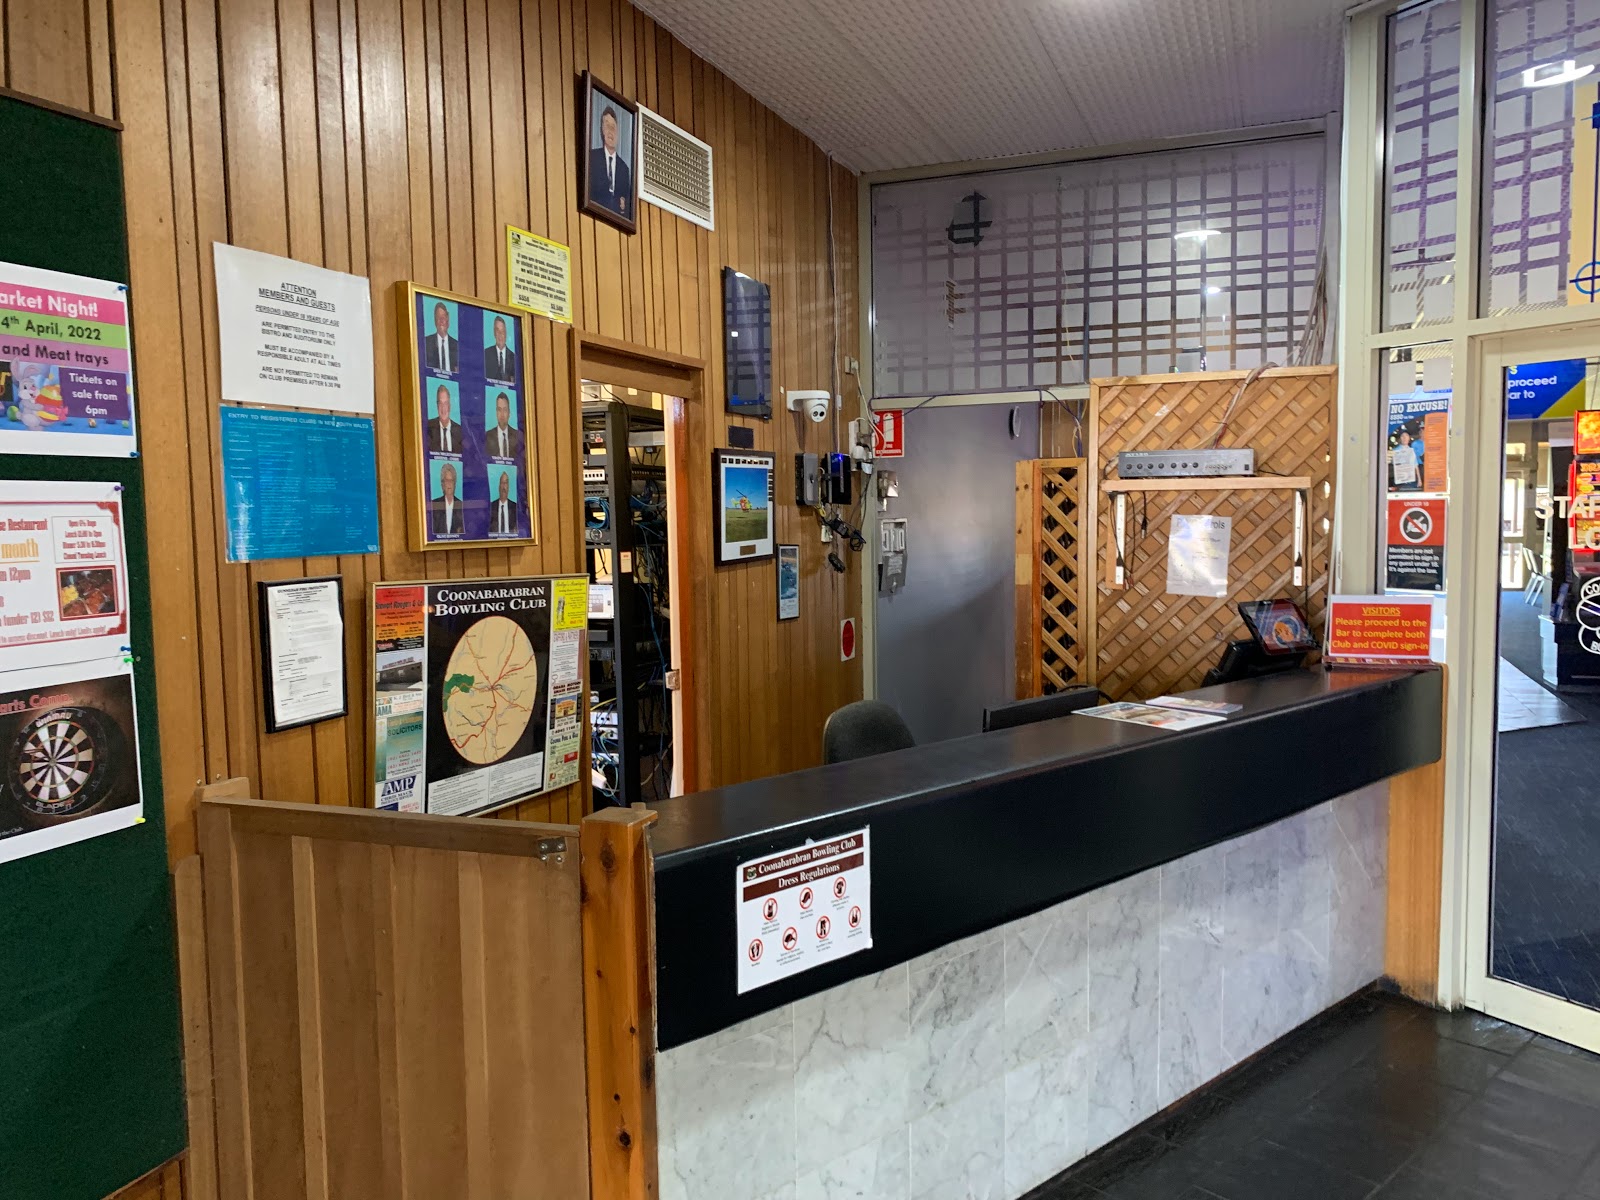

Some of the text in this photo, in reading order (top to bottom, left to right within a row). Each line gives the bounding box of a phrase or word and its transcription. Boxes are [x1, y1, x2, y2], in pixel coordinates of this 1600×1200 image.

[281, 282, 317, 298] ATTENTION
[47, 295, 99, 318] Night!
[258, 287, 336, 312] MEMBERS AND GUESTS
[255, 304, 281, 317] PERSONS
[282, 310, 299, 319] UNDER
[306, 315, 322, 323] YEARS
[330, 319, 340, 327] AGE
[25, 320, 63, 338] April,
[67, 325, 102, 341] 2022
[273, 322, 302, 333] PERMITTED
[261, 328, 281, 337] BISTRO
[293, 334, 323, 344] AUDITORIUM
[2, 344, 109, 367] and Meat trays
[257, 350, 293, 361] RESPONSIBLE
[294, 356, 310, 364] ADULT
[288, 348, 323, 358] ACCOMPANIED
[69, 372, 118, 386] Tickets on
[285, 369, 313, 379] PERMITTED
[283, 376, 308, 385] PREMISES
[308, 378, 324, 387] AFTER
[1508, 375, 1558, 389] proceed
[72, 389, 118, 401] sale from
[1507, 389, 1536, 400] ar to
[85, 405, 108, 416] 6pm
[1391, 399, 1448, 414] NO EXCUSE!
[228, 412, 249, 420] ENTRY
[260, 415, 298, 423] REGISTERED
[299, 417, 317, 425] CLUBS
[8, 518, 48, 531] Restaurant
[1, 538, 39, 559] month
[1388, 560, 1398, 568] any
[9, 567, 31, 583] 12pm
[437, 586, 546, 603] COONABARABRAN
[434, 598, 547, 617] BOWLING CLUB
[1362, 606, 1401, 616] VISITORS
[1335, 618, 1363, 626] Please
[1364, 619, 1400, 627] proceed
[1412, 619, 1428, 627] the
[1335, 629, 1426, 639] Bar to complete both
[1332, 640, 1429, 651] Club and COVID sign-in
[29, 693, 74, 708] Comp.
[387, 723, 424, 737] SOLICITORS
[385, 777, 414, 796] AMP
[758, 838, 856, 874] Coonabarabran Bowling Club
[778, 864, 840, 888] Dress Regulations
